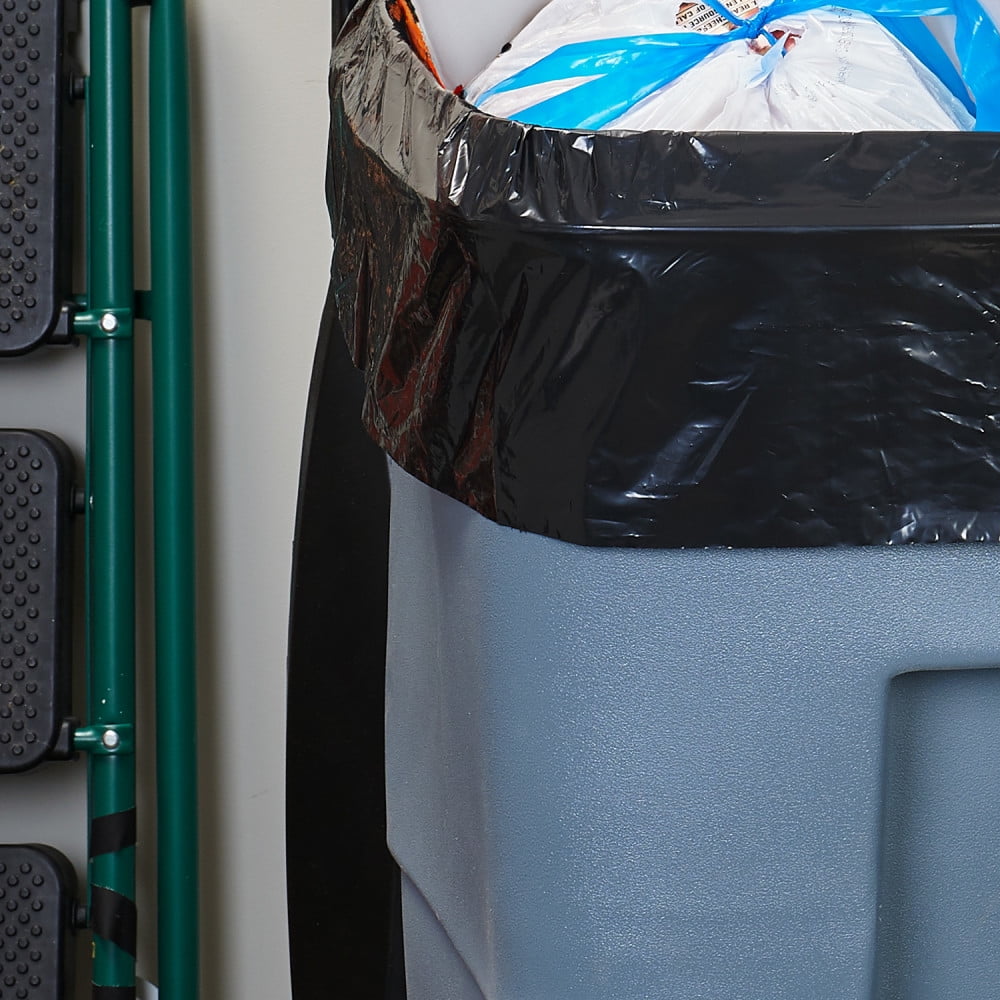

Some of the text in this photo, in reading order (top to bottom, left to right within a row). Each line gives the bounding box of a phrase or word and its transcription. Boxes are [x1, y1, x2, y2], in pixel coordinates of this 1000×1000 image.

[694, 3, 706, 13] OF
[732, 2, 750, 14] REA
[675, 10, 693, 24] CAL
